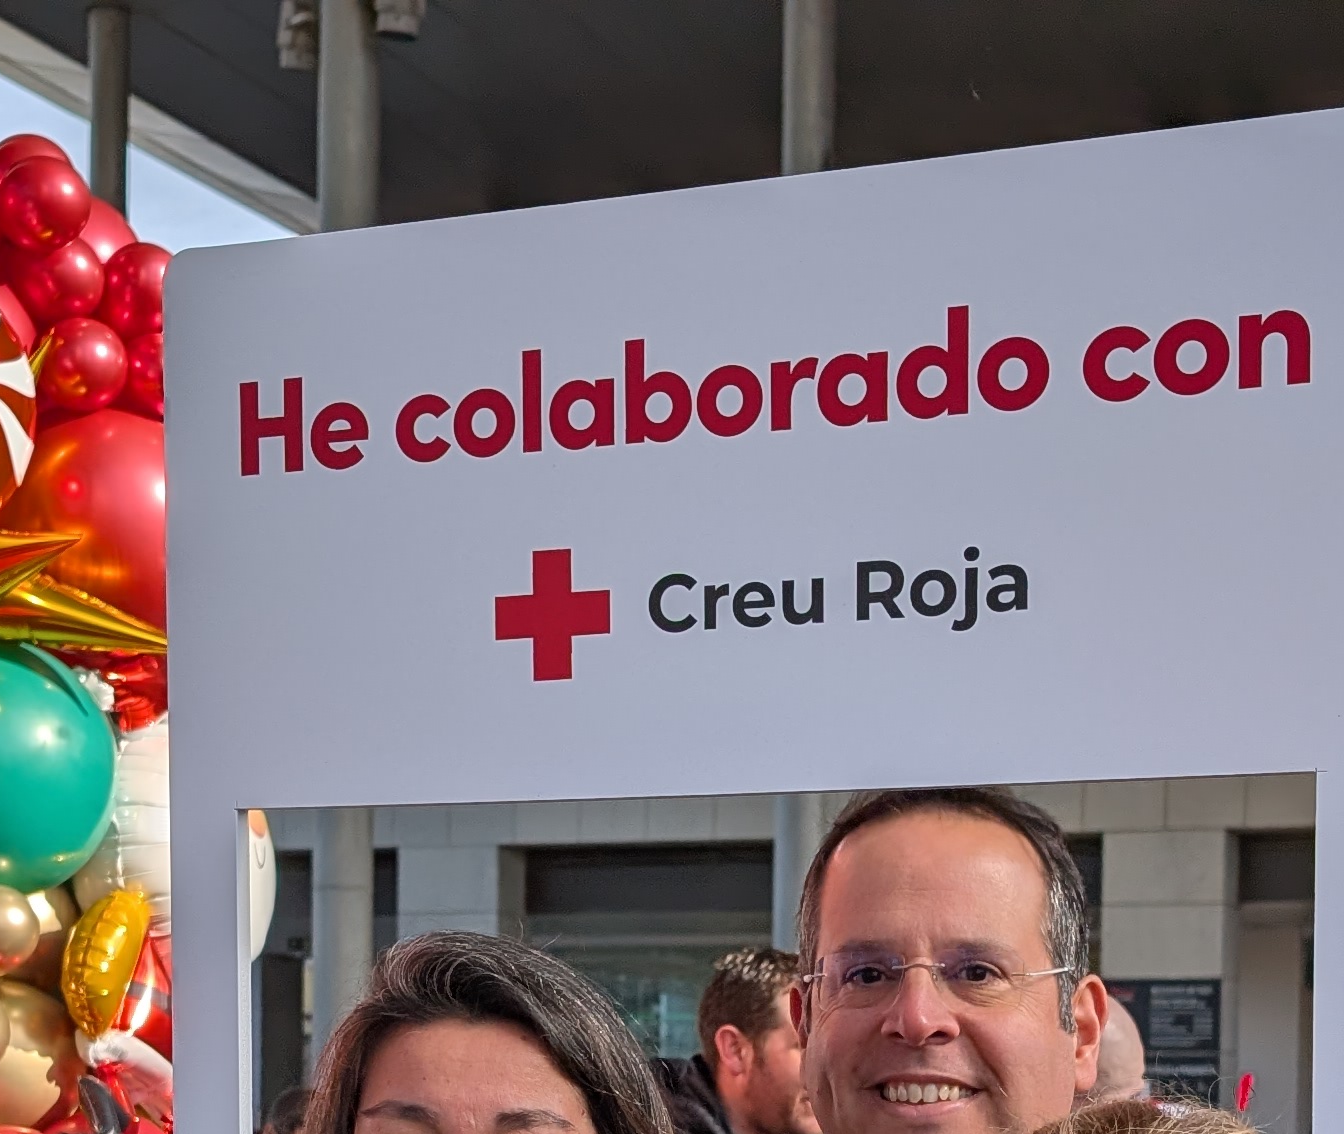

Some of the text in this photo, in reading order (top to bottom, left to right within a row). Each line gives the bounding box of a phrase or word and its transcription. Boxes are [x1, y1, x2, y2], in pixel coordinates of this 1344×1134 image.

[239, 304, 1312, 476] He colaborado con
[647, 546, 1030, 633] Creu Roja
